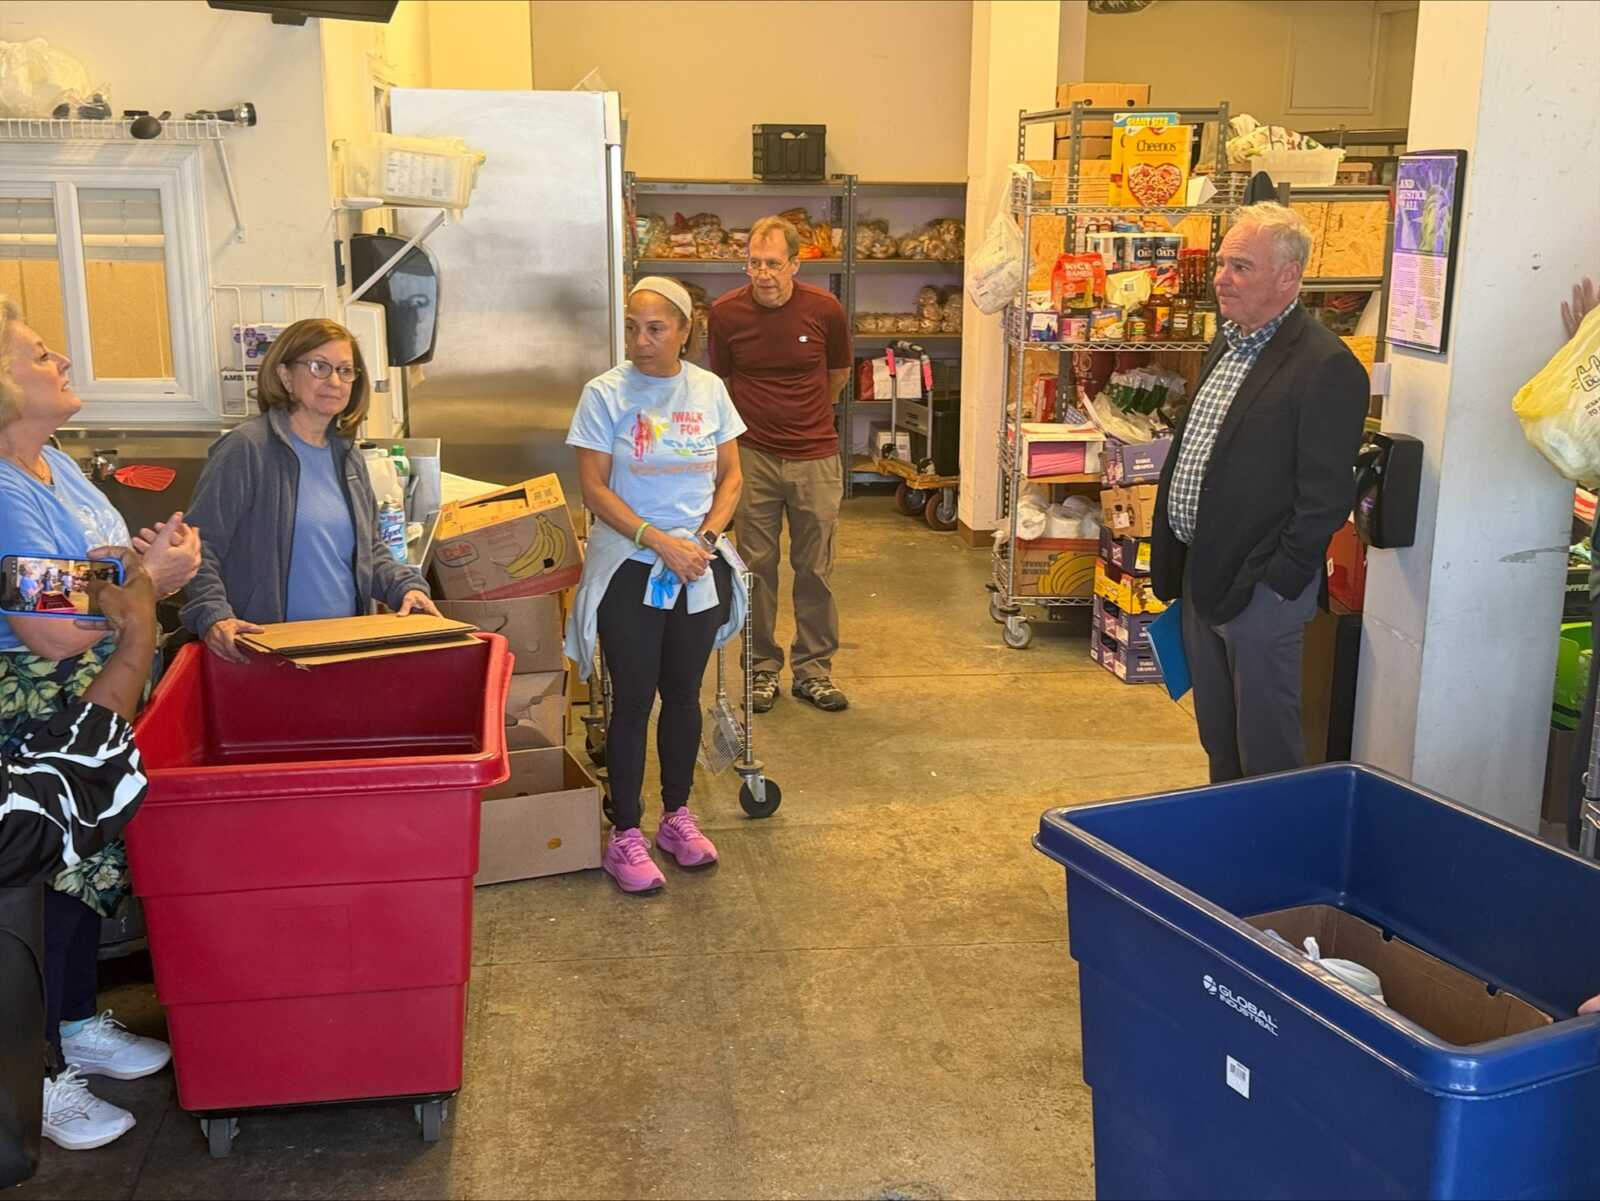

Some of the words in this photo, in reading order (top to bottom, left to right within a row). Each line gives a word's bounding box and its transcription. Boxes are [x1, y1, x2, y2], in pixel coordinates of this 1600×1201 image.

[680, 423, 701, 435] FOR
[1218, 984, 1279, 1029] GLOBAL
[1219, 993, 1279, 1037] INDUSTRIAL
